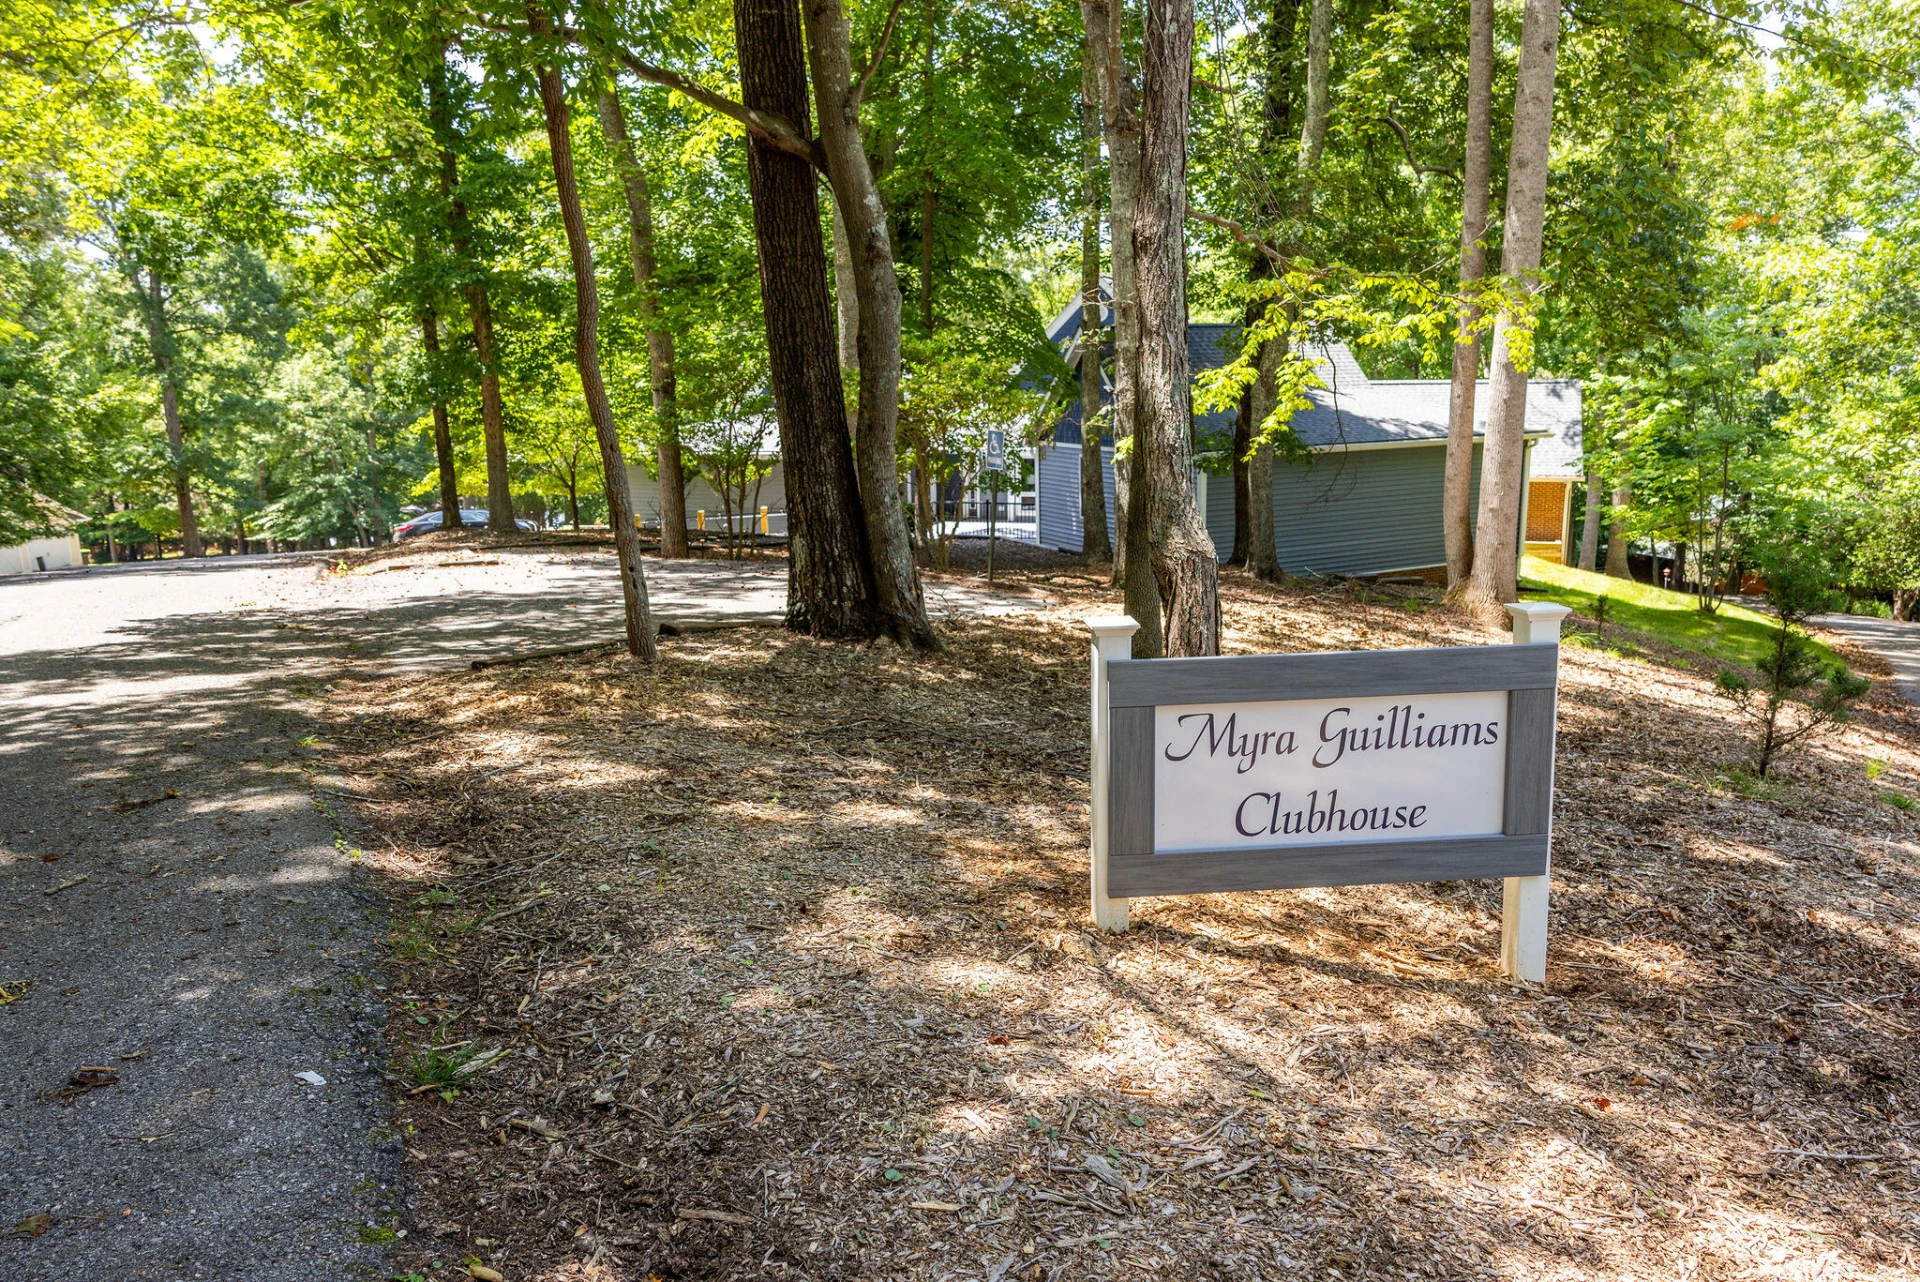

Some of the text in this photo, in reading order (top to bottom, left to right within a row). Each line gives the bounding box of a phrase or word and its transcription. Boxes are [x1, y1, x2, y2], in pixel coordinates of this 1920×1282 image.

[1164, 704, 1499, 775] Myra Guilliams
[1235, 788, 1428, 838] Clubhouse
